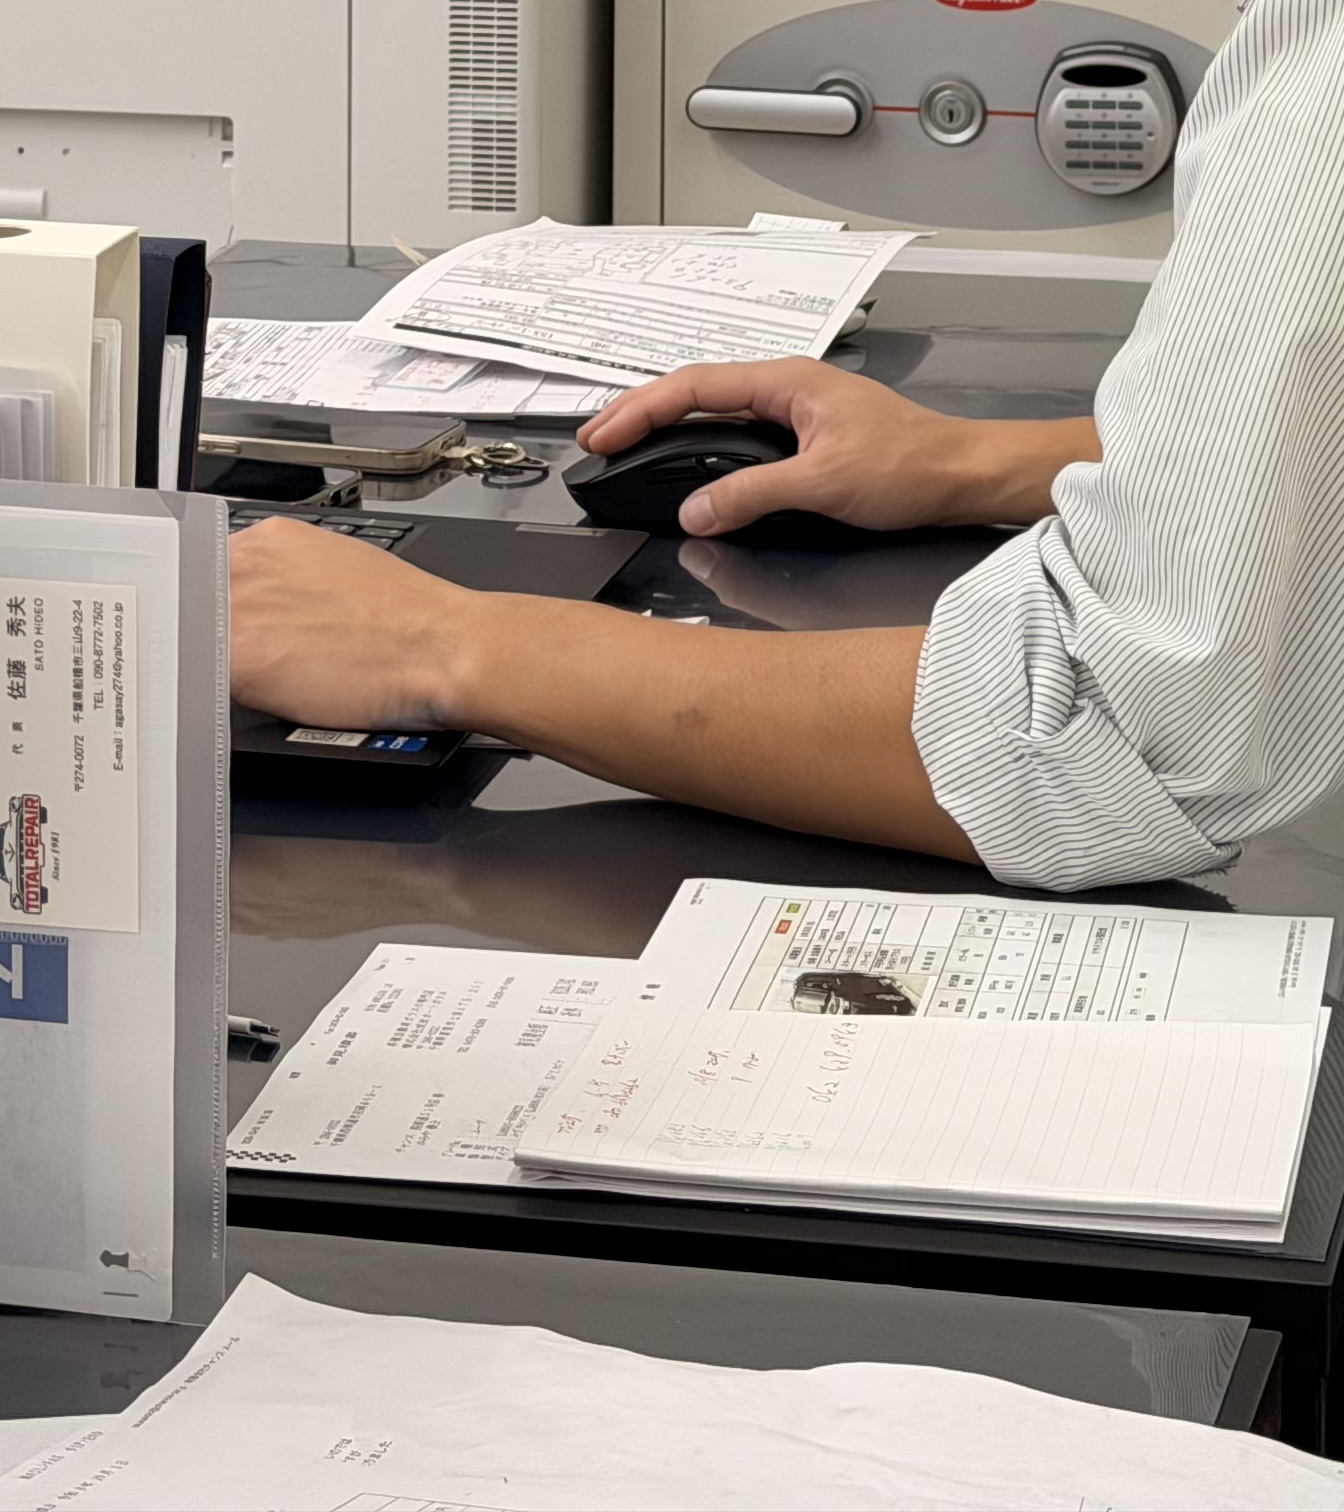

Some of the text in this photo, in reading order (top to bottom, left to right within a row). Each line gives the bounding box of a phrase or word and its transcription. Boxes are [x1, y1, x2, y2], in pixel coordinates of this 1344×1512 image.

[6, 595, 27, 701] 佐藤 秀夫
[34, 639, 45, 672] SATO
[23, 797, 42, 913] TOTALREPAIR
